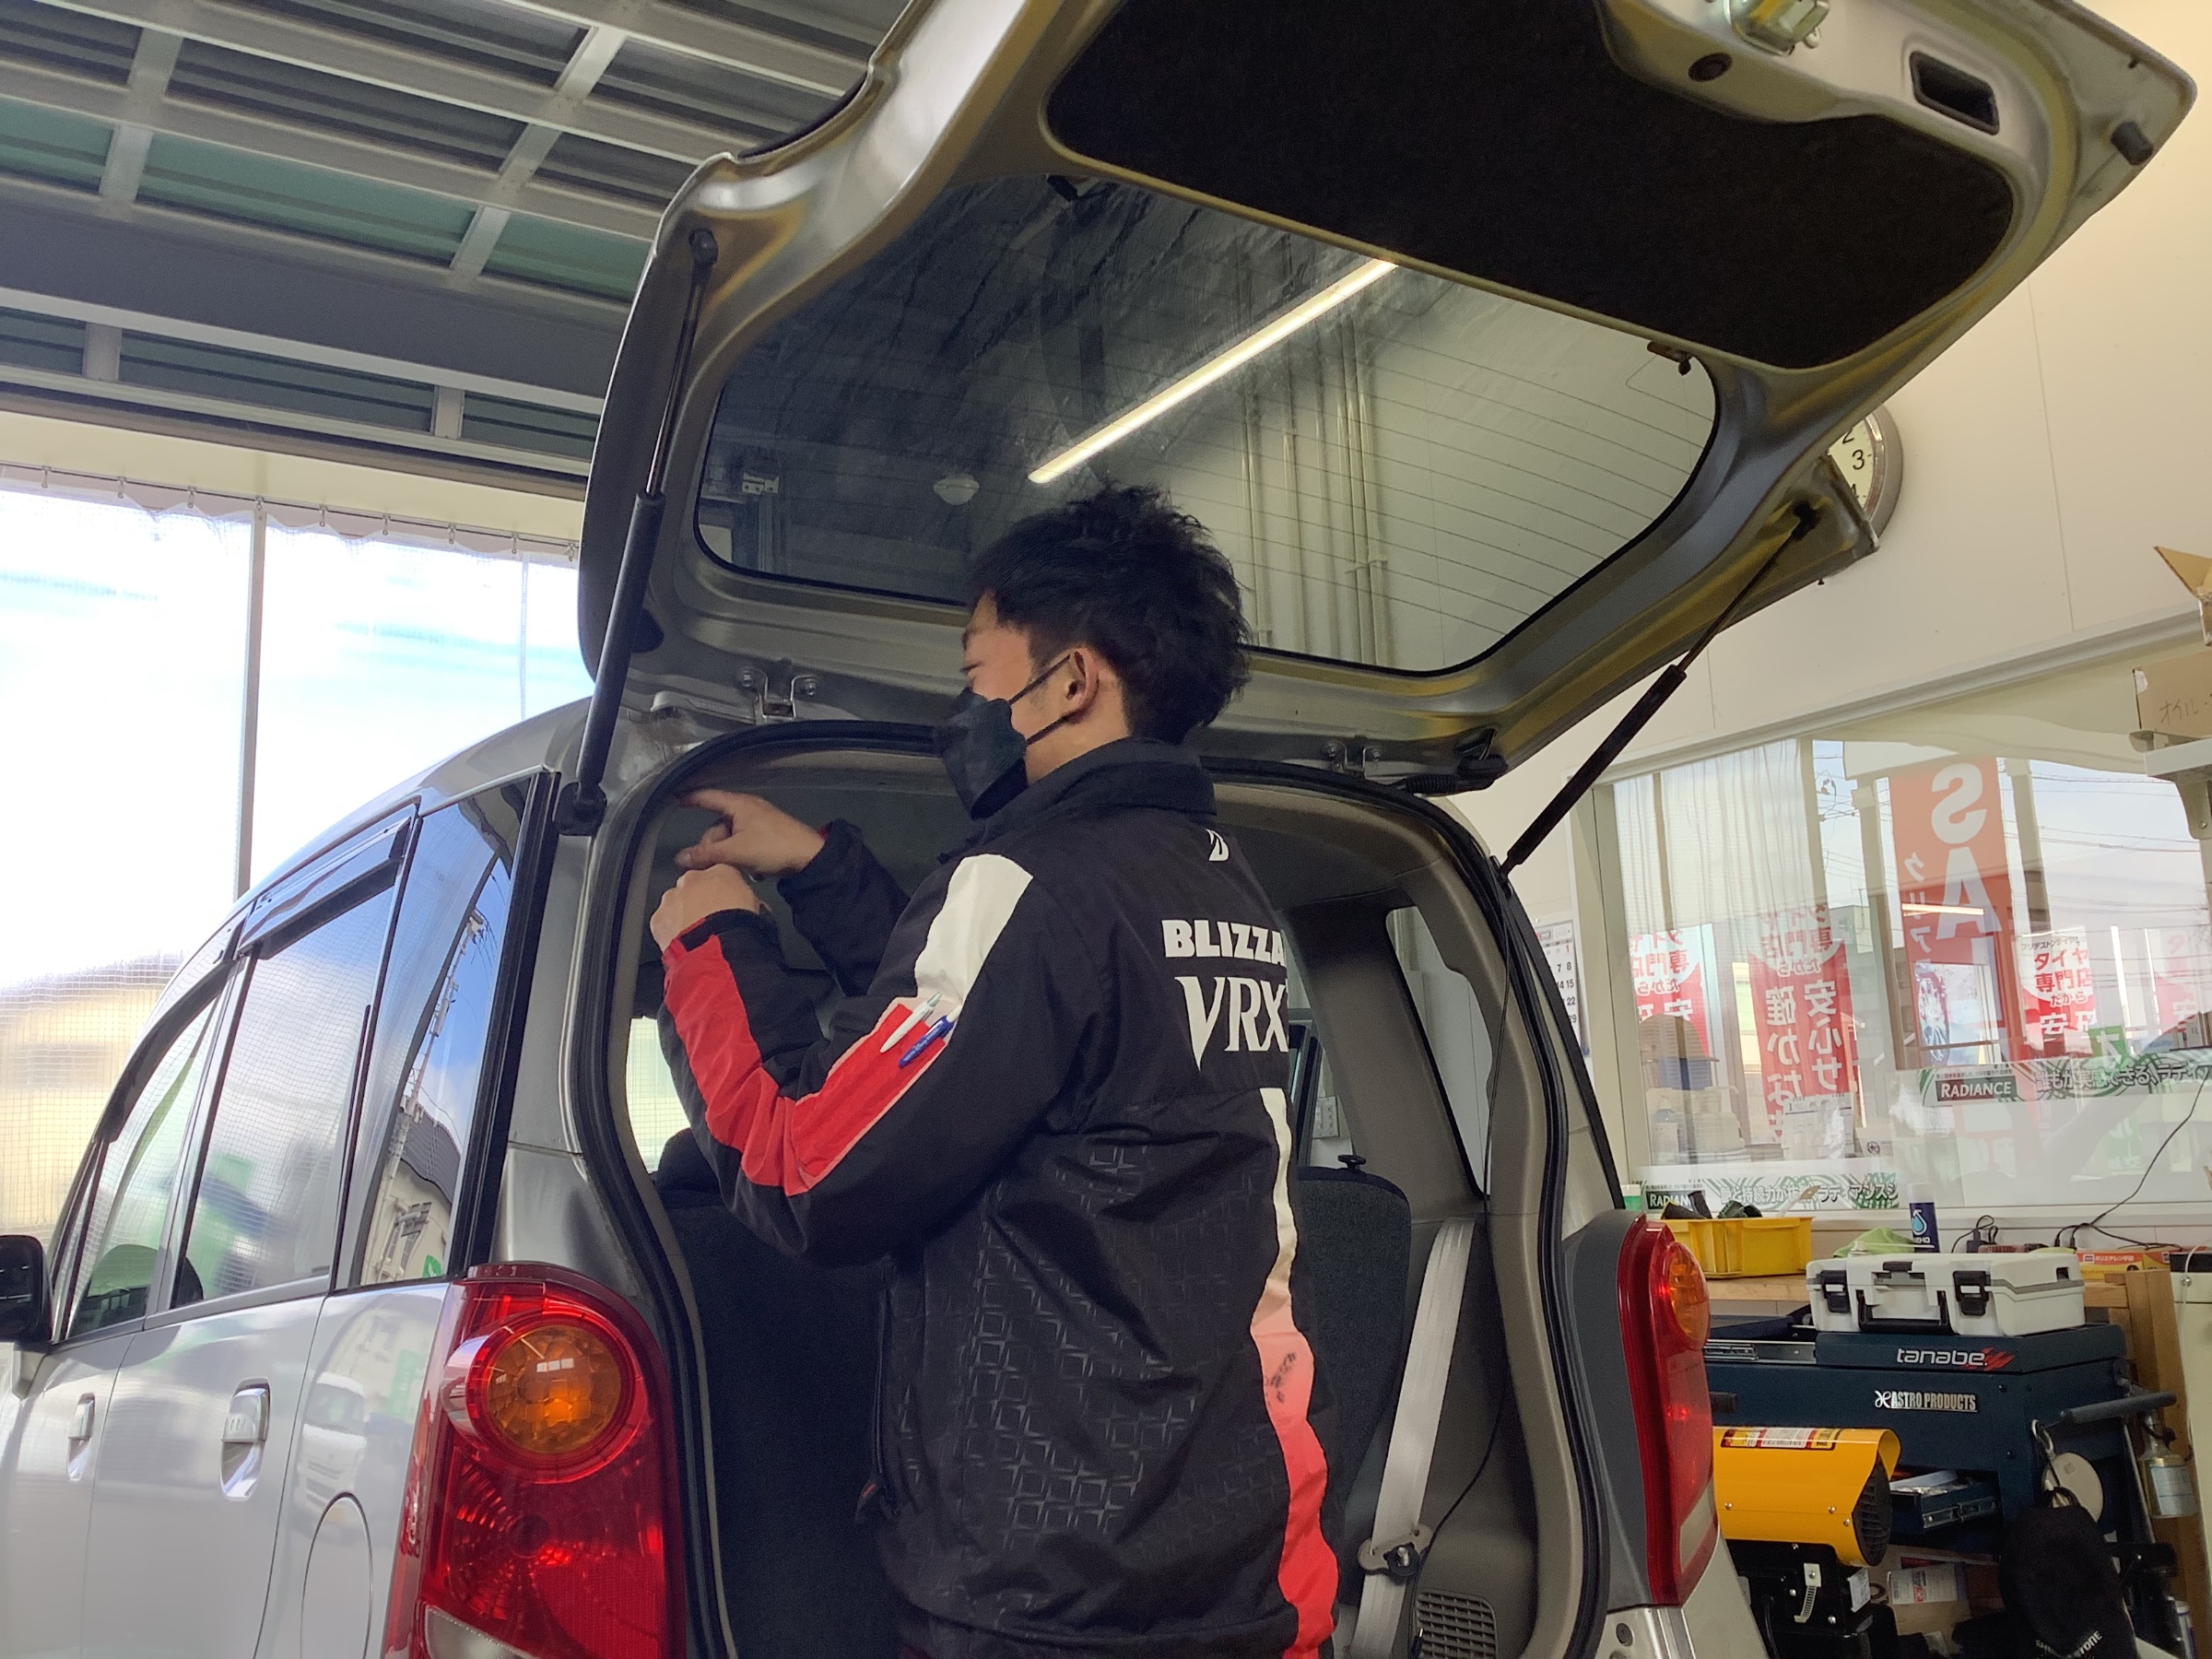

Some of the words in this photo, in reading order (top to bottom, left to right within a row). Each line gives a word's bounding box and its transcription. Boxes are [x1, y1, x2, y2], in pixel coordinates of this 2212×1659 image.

[1852, 449, 1865, 470] 3
[1161, 919, 1288, 967] BLIZZA
[1557, 963, 1562, 973] 7
[1566, 961, 1572, 971] 8
[2033, 947, 2090, 971] タイヤ
[1566, 978, 1574, 989] 15
[2033, 969, 2093, 994] 専門店
[1567, 996, 1576, 1006] 22
[2050, 991, 2088, 1007] だから
[1174, 976, 1289, 1072] VRX
[1940, 1081, 2012, 1099] RADIANCE
[1649, 1193, 1692, 1208] RADIAN
[1890, 1390, 1923, 1409] ASTRO
[1924, 1393, 1976, 1411] PRODUCTS
